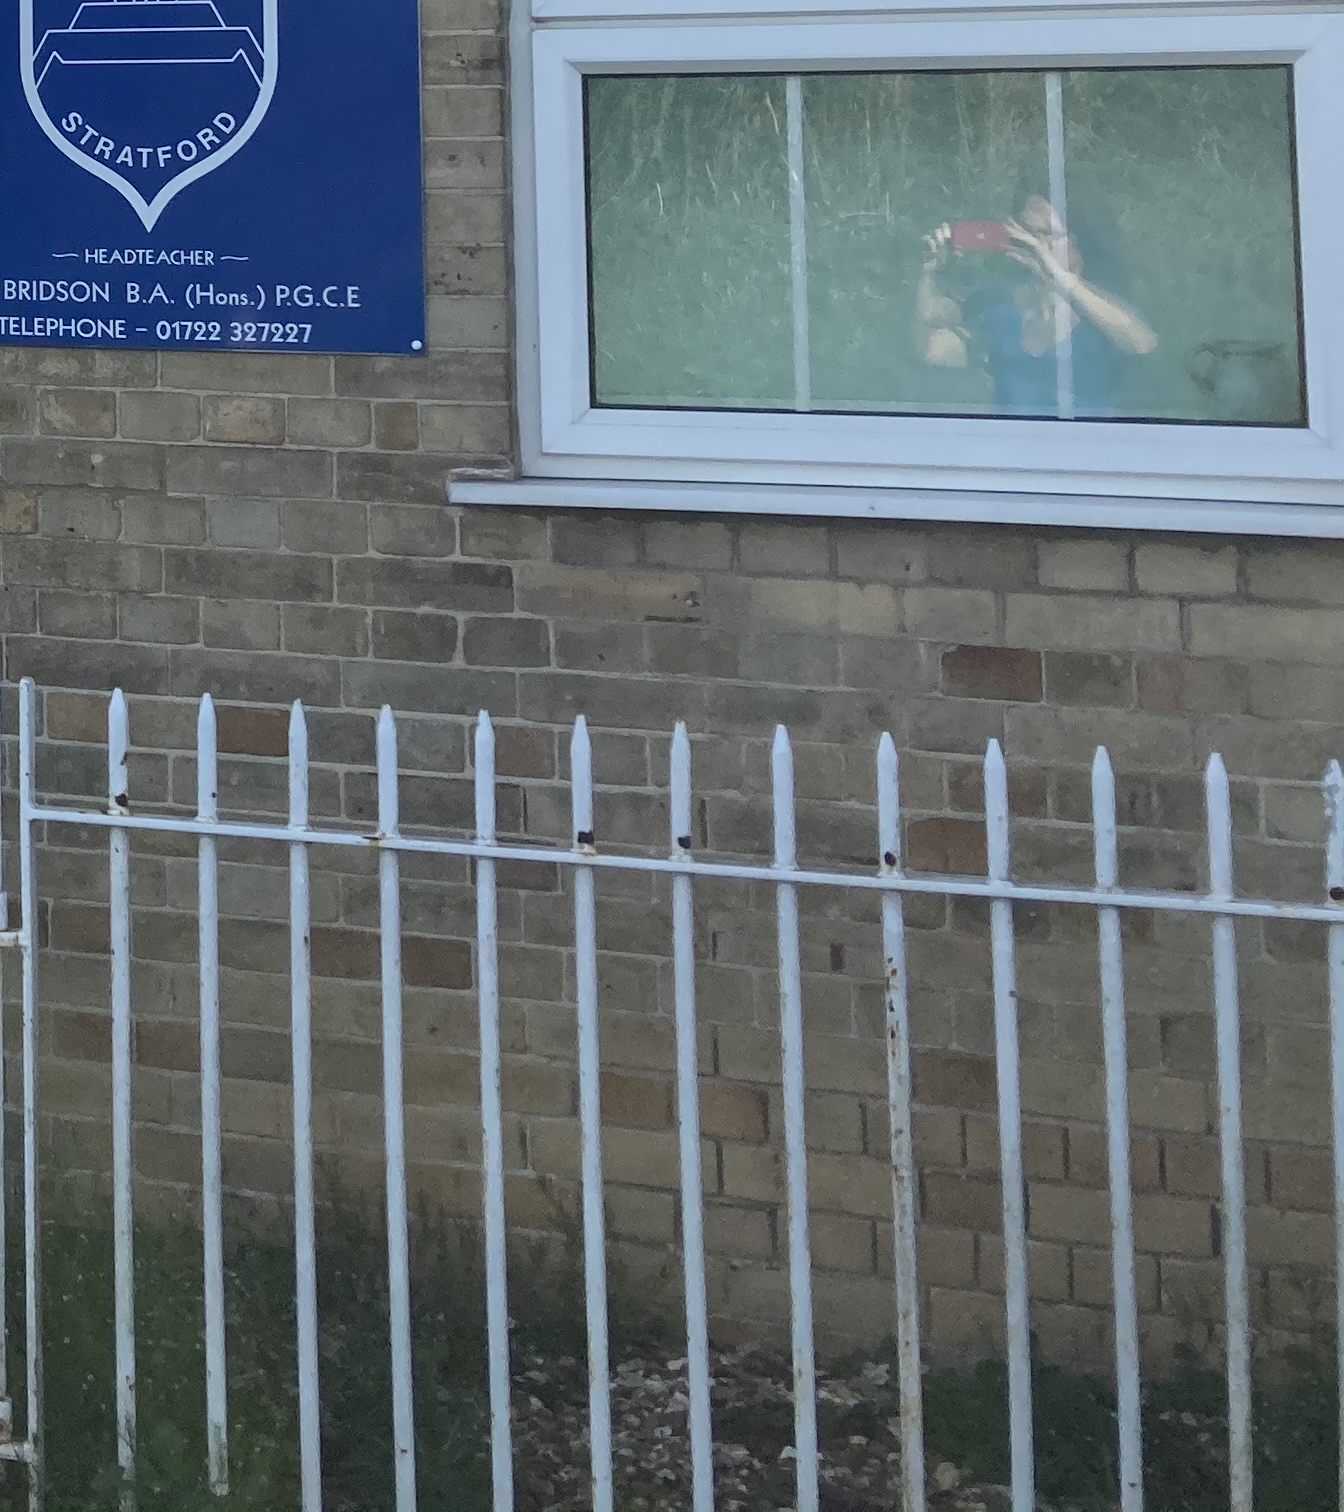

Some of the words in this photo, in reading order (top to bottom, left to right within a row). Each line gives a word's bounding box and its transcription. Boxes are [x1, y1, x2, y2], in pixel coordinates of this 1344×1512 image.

[61, 110, 237, 169] STRATFORD
[84, 248, 215, 266] HEADTEACHER
[3, 279, 110, 304] BRIDSON
[126, 282, 175, 305] B.A.
[185, 283, 266, 311] (Hons.)
[275, 284, 361, 309] P.G.C.E
[155, 320, 221, 342] 01722
[229, 321, 312, 345] 327227
